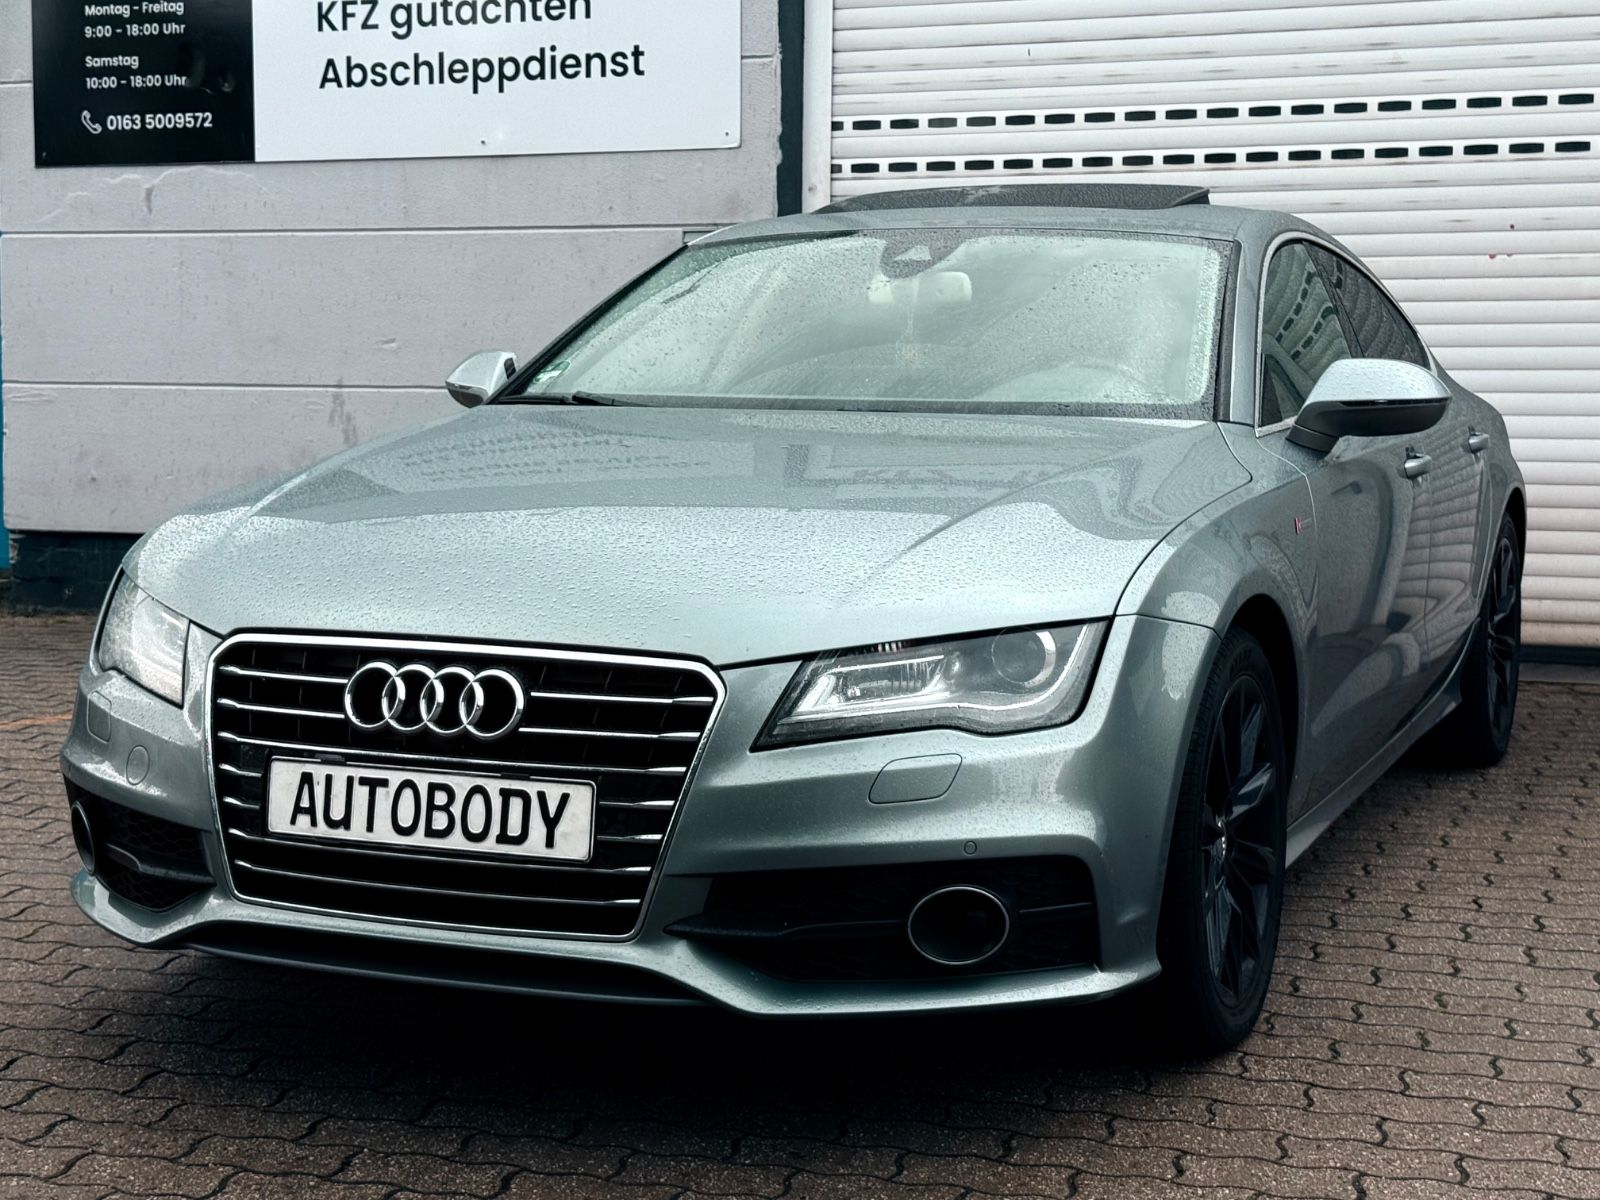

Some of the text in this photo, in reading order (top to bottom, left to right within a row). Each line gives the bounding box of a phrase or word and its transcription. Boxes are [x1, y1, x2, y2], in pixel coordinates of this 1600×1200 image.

[84, 4, 130, 18] Montag
[141, 0, 185, 15] Freitag
[316, 0, 592, 40] KFZ gutachten
[84, 25, 113, 38] 9:00
[125, 22, 160, 37] 18:00
[162, 22, 186, 35] Uhr
[84, 55, 139, 70] Samstag
[319, 45, 646, 94] Abschleppdienst
[85, 76, 118, 89] 10:00
[130, 74, 162, 88] 18:00
[164, 73, 187, 87] Uhr
[106, 111, 213, 131] 0163 5009572
[289, 771, 571, 850] AUTOBODY
